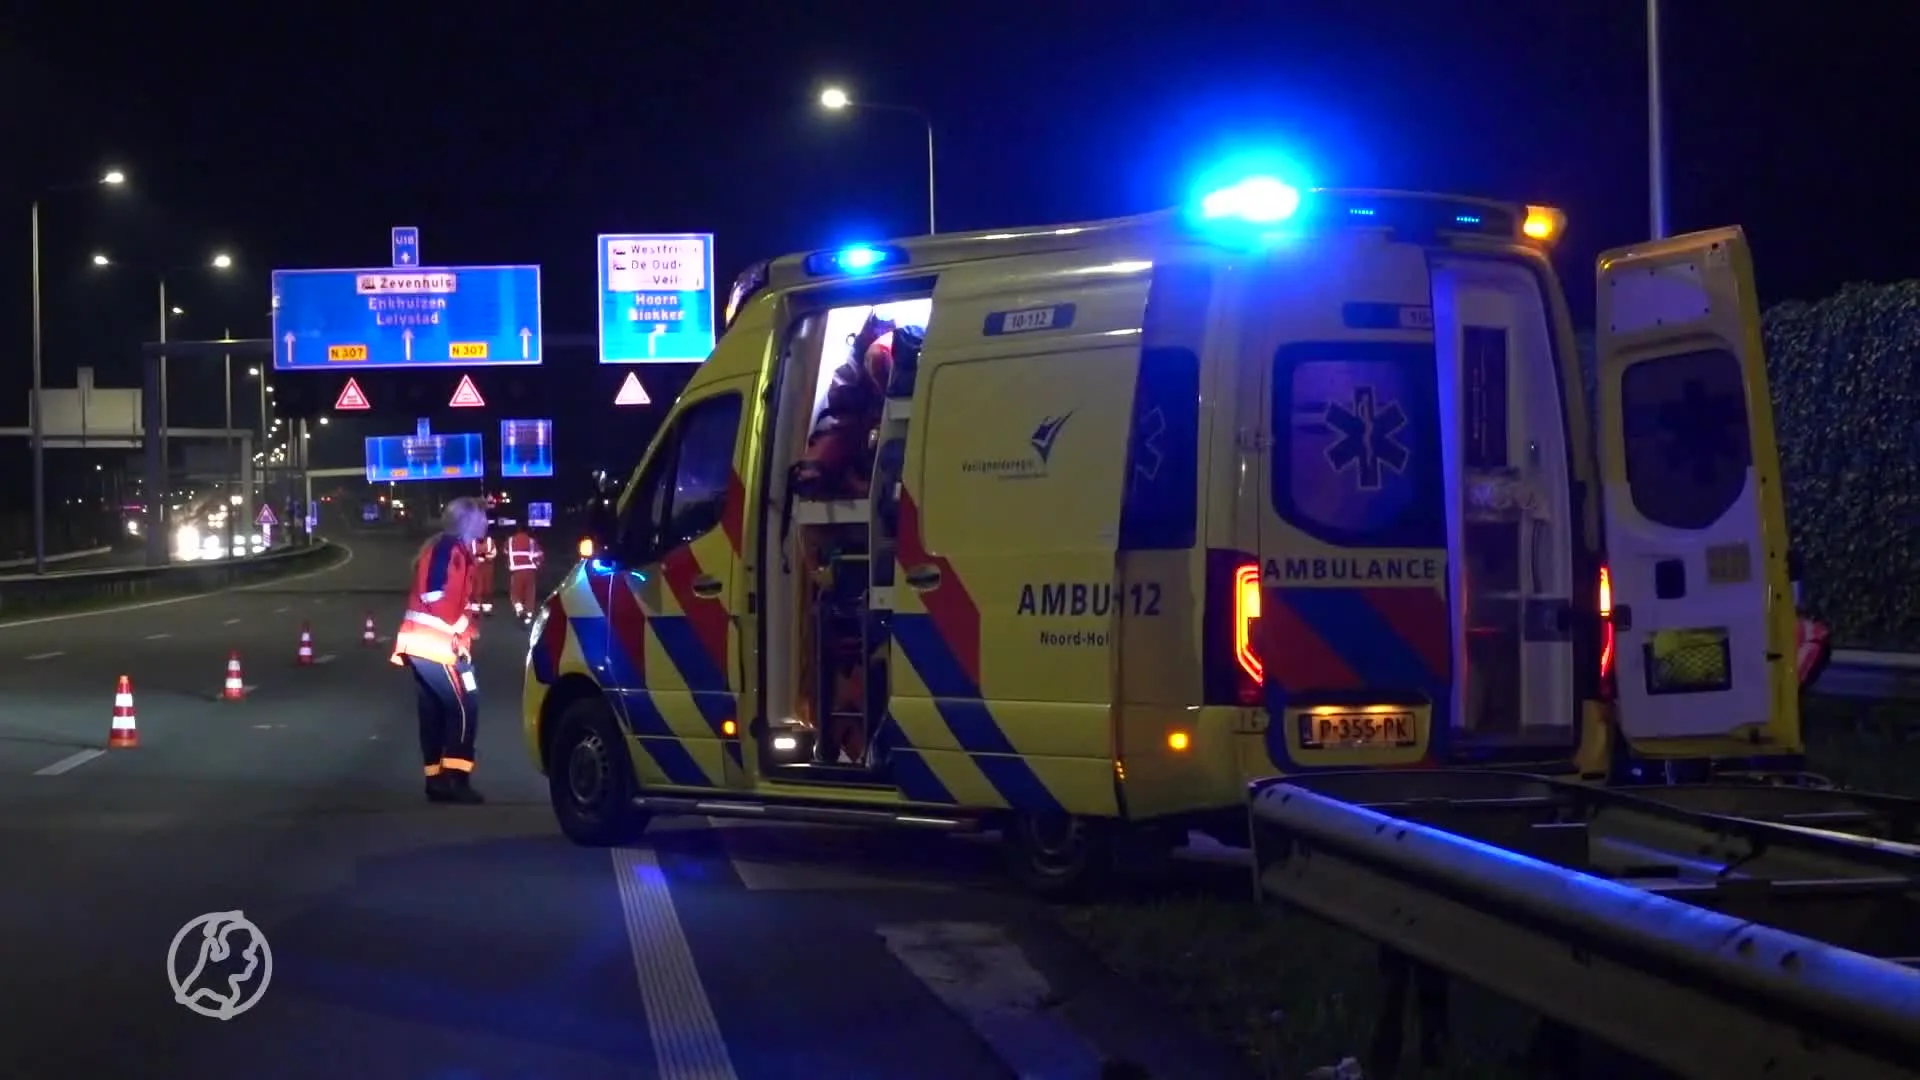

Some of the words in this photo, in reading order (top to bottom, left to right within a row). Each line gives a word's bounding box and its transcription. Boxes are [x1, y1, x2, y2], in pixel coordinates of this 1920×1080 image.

[631, 244, 682, 255] Westfri
[631, 259, 647, 270] De
[380, 276, 452, 288] Zevenhuis
[652, 274, 682, 285] Veil
[369, 296, 446, 310] Enkhuizen
[464, 345, 484, 355] 307
[1263, 559, 1436, 579] AMBULANCE
[1017, 583, 1110, 616] AMBU
